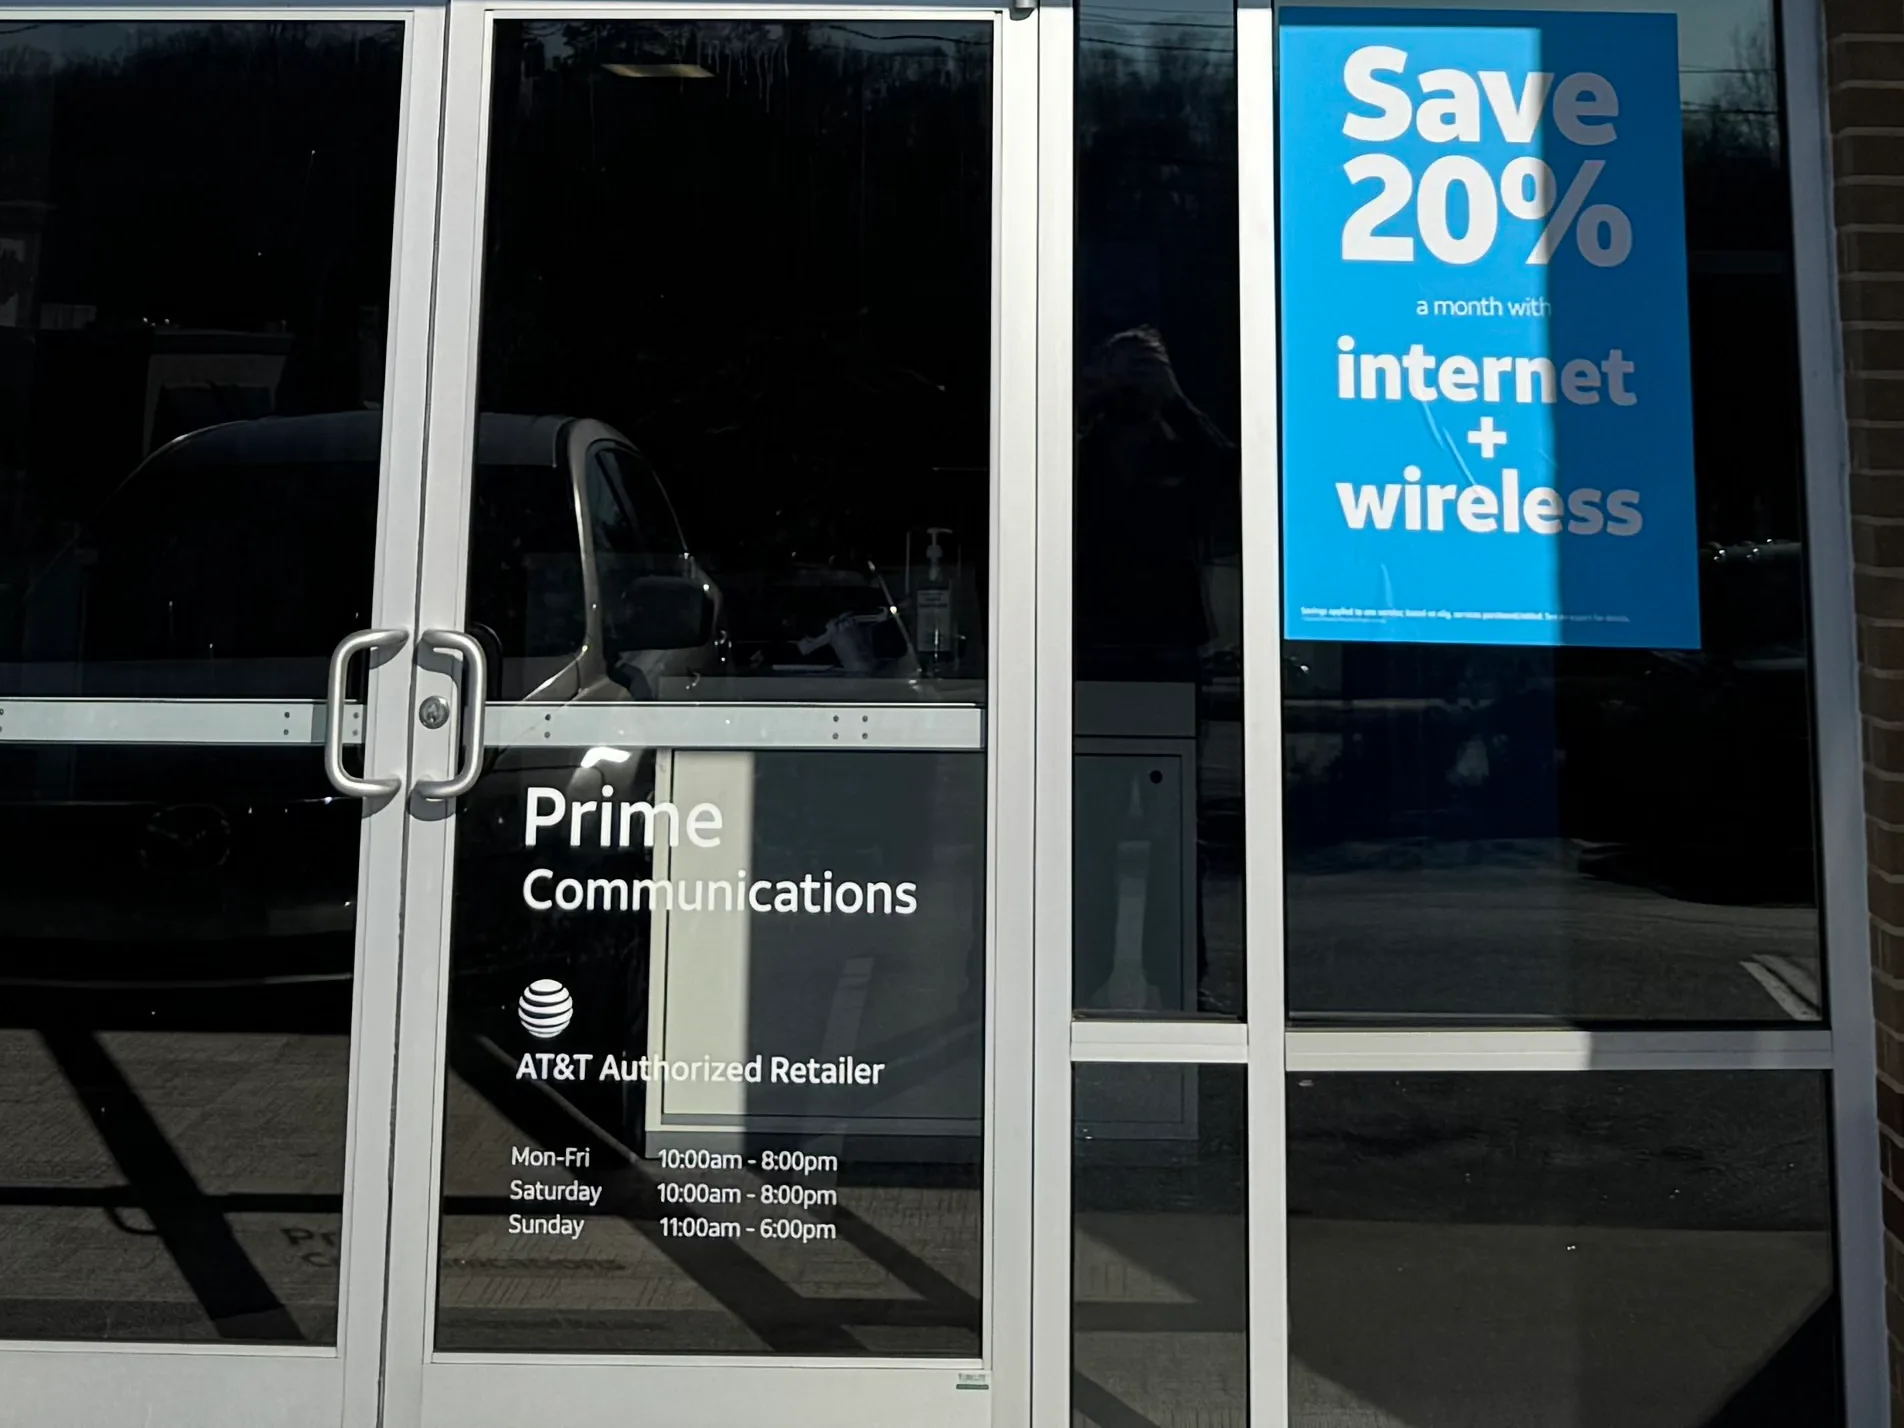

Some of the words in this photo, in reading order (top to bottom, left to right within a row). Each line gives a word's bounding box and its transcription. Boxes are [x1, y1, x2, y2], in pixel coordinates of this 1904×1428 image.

[1342, 45, 1620, 146] Save
[1341, 154, 1633, 268] 20%
[1416, 300, 1429, 316] a
[1433, 297, 1503, 316] month
[1507, 298, 1552, 317] with
[1337, 335, 1638, 406] internet
[1335, 465, 1644, 537] wireless
[524, 784, 724, 848] Prime
[522, 868, 918, 915] Communications
[516, 1053, 594, 1081] AT&T
[598, 1054, 762, 1084] Authorized
[770, 1056, 886, 1085] Retailer
[511, 1146, 591, 1168] Mon-Fri
[657, 1149, 743, 1170] 10:00am
[760, 1150, 838, 1176] 8:00pm
[509, 1179, 603, 1207] Saturday
[657, 1182, 742, 1204] 10:00am
[760, 1184, 837, 1210] 8:00pm
[508, 1214, 585, 1240] Sunday
[659, 1216, 742, 1238] 11:00am
[759, 1218, 837, 1244] 6:00pm
